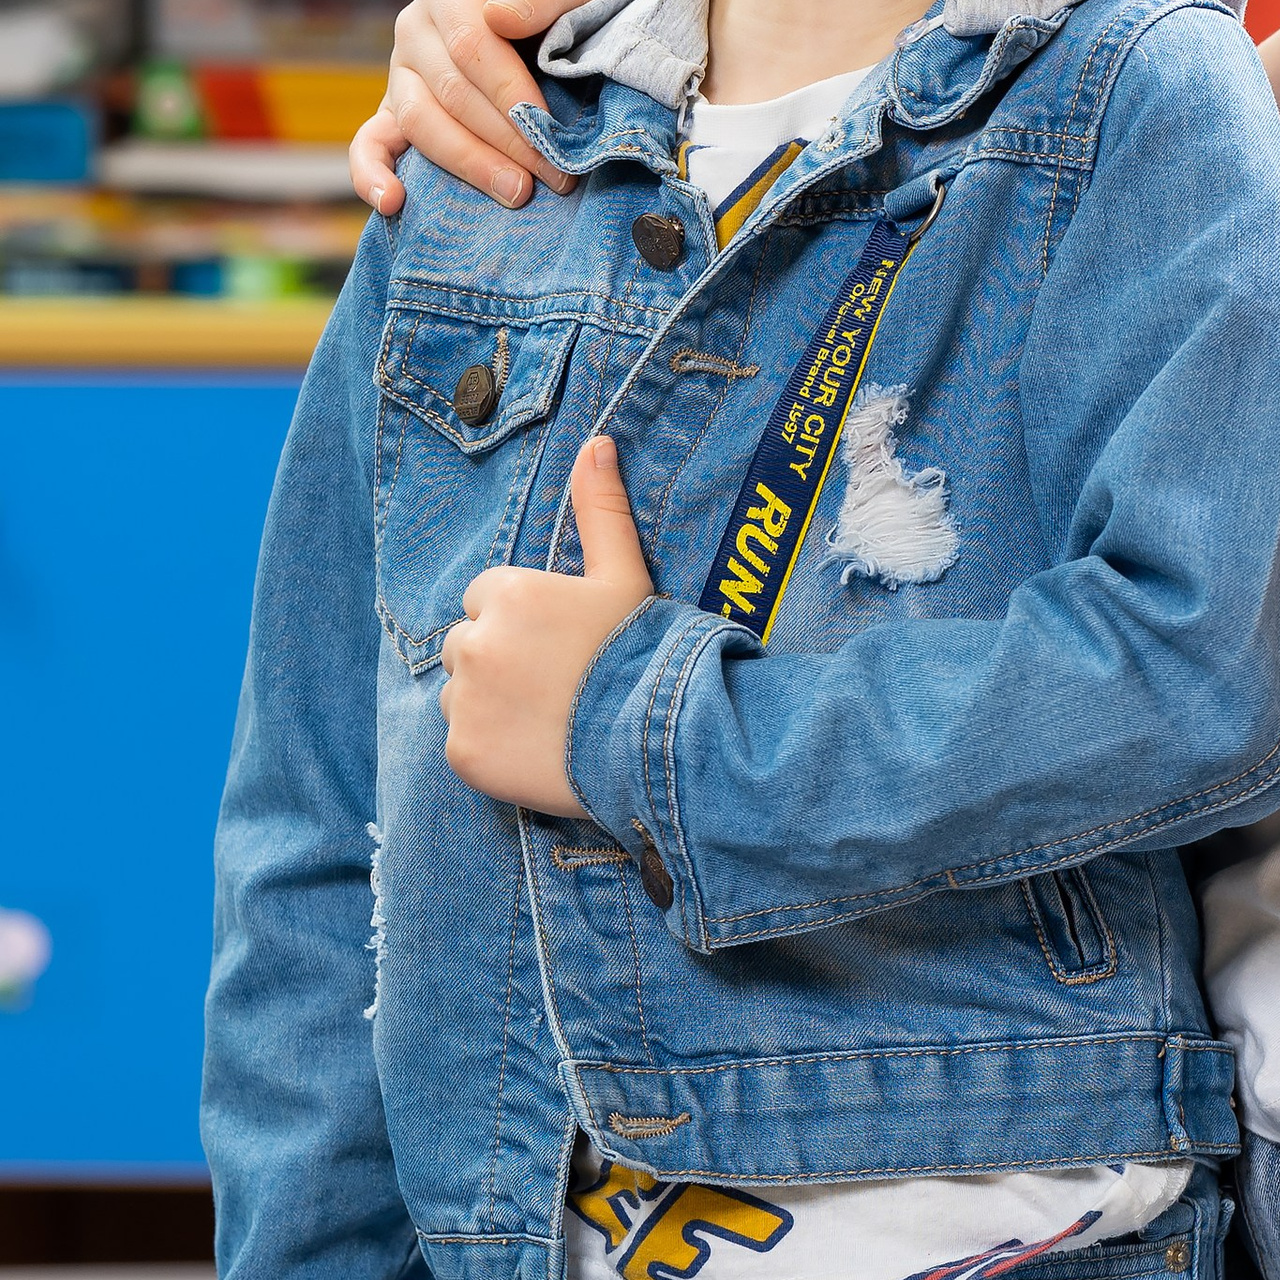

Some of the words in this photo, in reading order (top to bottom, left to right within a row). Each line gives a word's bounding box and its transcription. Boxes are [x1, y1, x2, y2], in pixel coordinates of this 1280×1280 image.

[825, 283, 865, 345] Original
[855, 259, 894, 322] NEW
[798, 348, 830, 399] Brand
[813, 327, 861, 408] YOUR
[781, 401, 805, 444] 1997
[789, 414, 825, 481] CITY
